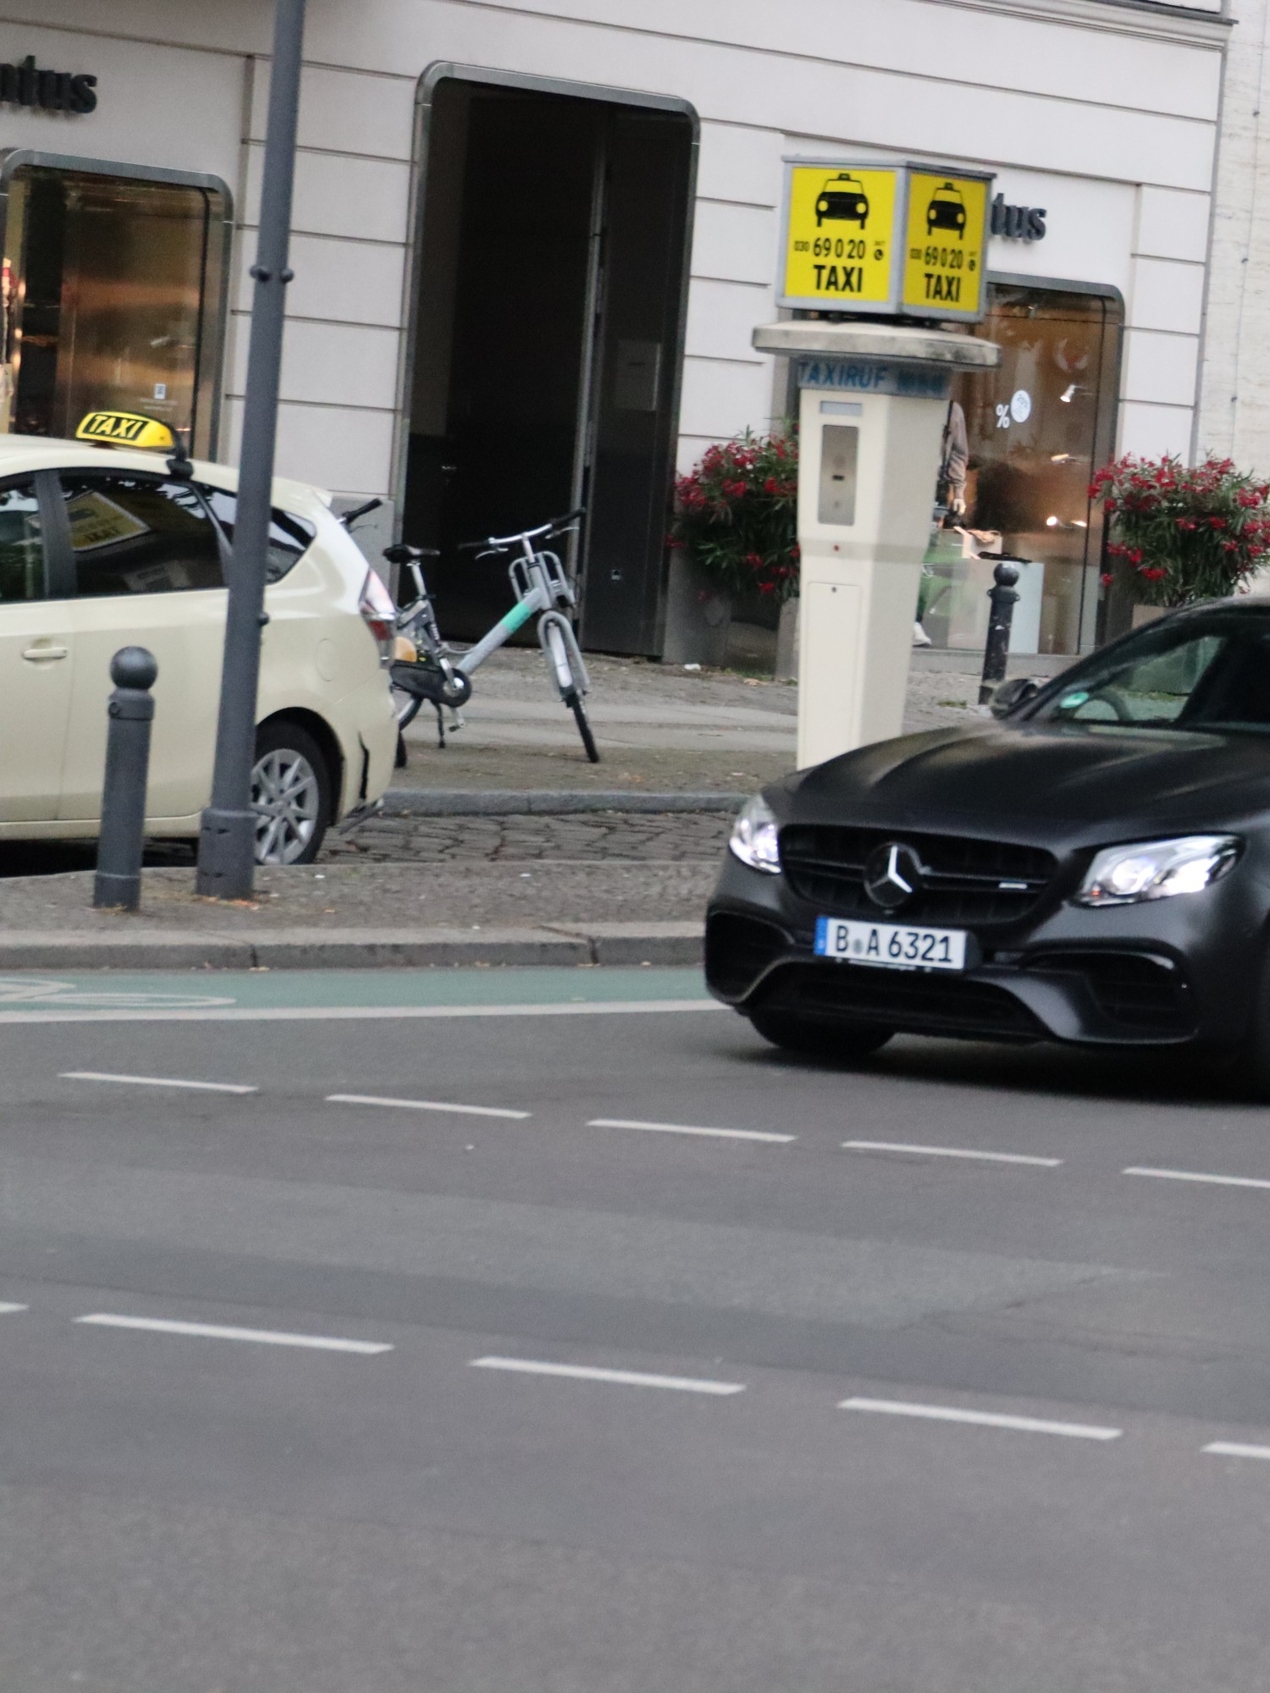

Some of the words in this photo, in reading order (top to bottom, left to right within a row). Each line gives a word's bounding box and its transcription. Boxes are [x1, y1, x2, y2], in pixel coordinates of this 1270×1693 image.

[813, 264, 864, 293] TAXI
[924, 273, 961, 303] TAXI
[799, 361, 888, 389] TAXIRUF
[89, 415, 144, 438] TAXI
[836, 925, 848, 952] B
[866, 929, 880, 956] A
[888, 931, 952, 963] 6321
